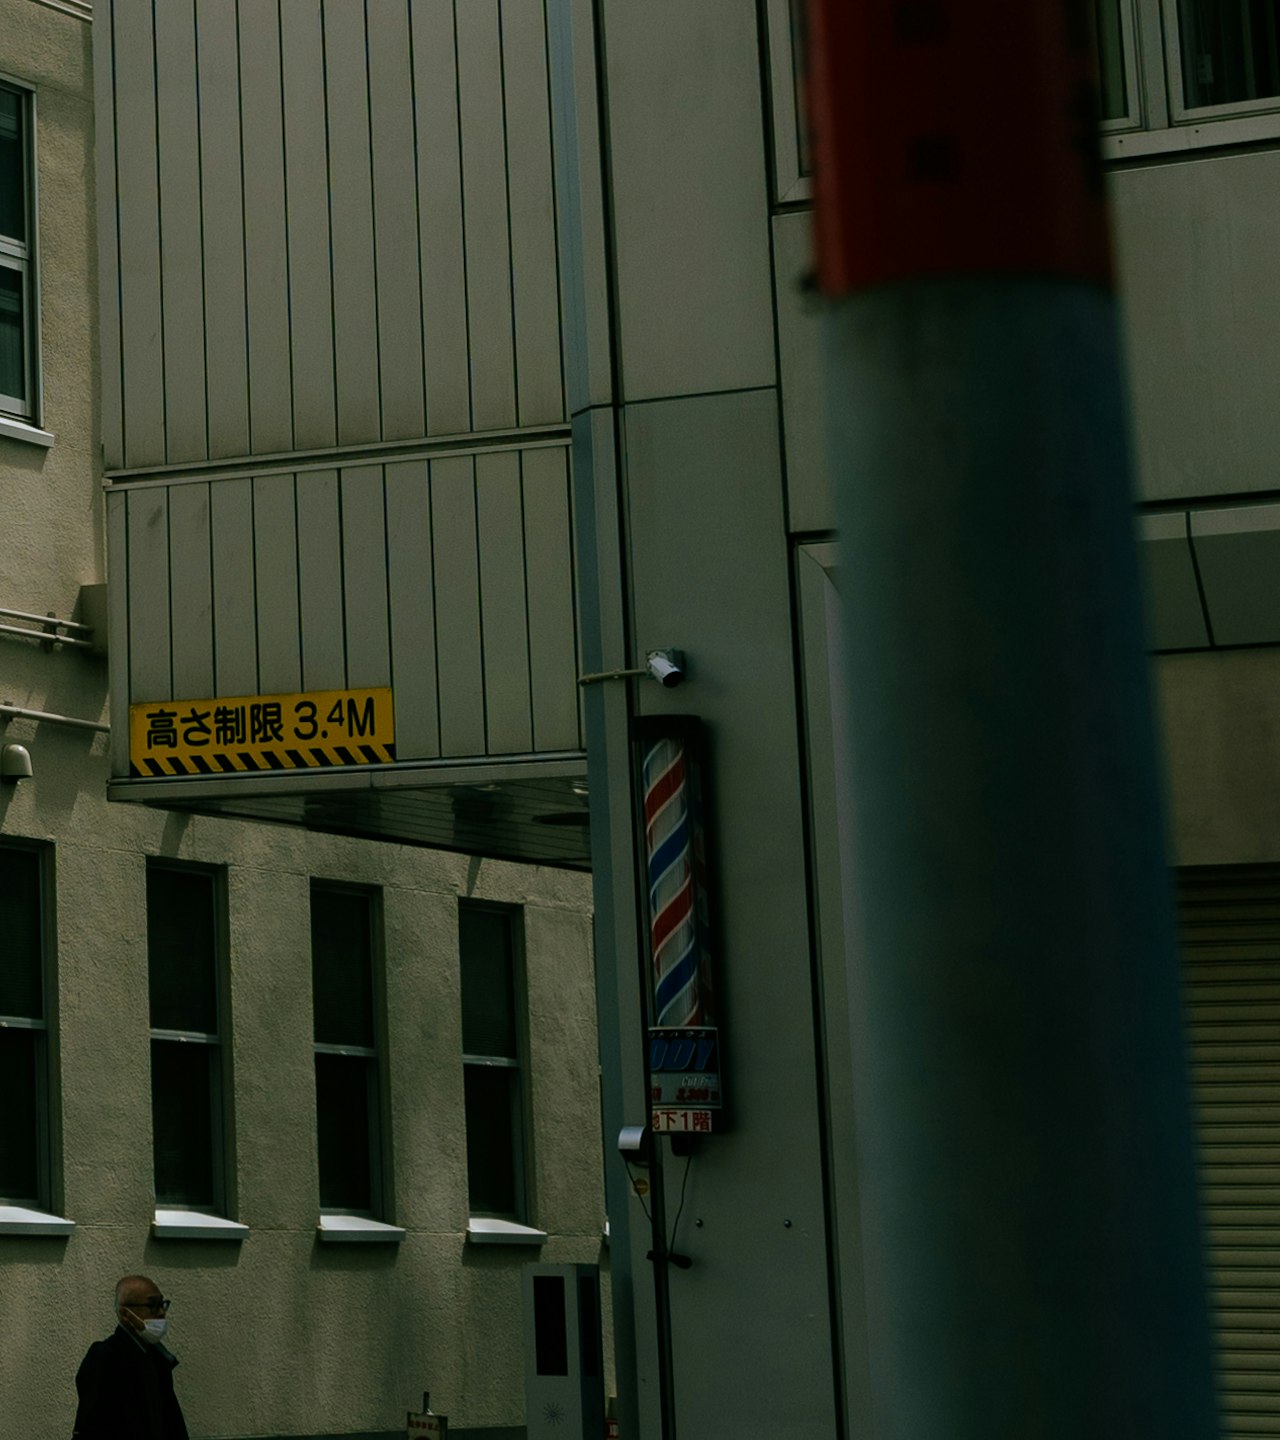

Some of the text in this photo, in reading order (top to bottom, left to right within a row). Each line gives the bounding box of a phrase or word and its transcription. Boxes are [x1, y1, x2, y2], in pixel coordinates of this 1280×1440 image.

[146, 697, 376, 750] 高さ制限 3.4M
